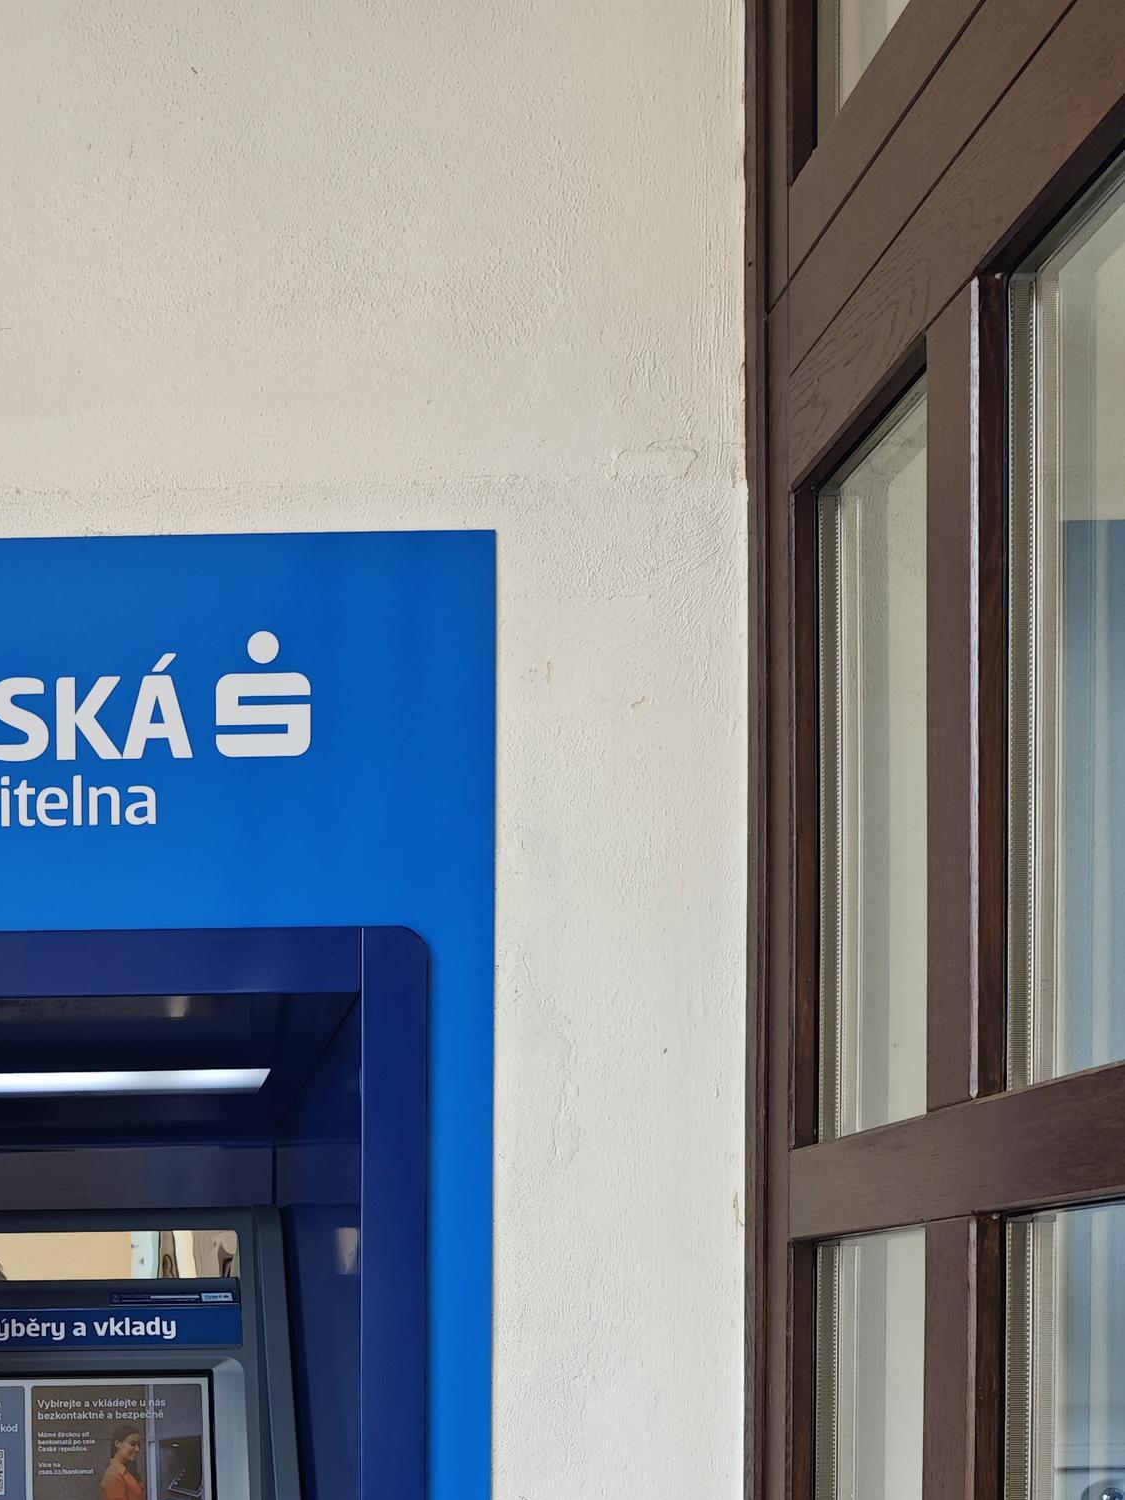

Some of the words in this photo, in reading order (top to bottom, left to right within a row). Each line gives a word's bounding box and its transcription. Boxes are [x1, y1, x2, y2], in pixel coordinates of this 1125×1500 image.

[72, 1321, 87, 1337] a
[93, 1316, 177, 1340] vklady
[37, 1399, 82, 1410] Vybírejte
[83, 1400, 90, 1408] a
[92, 1398, 137, 1409] vkládejte
[148, 1398, 166, 1407] nás
[37, 1410, 105, 1420] bezkontaktně
[115, 1409, 164, 1420] bezpečně
[0, 1423, 18, 1433] kód
